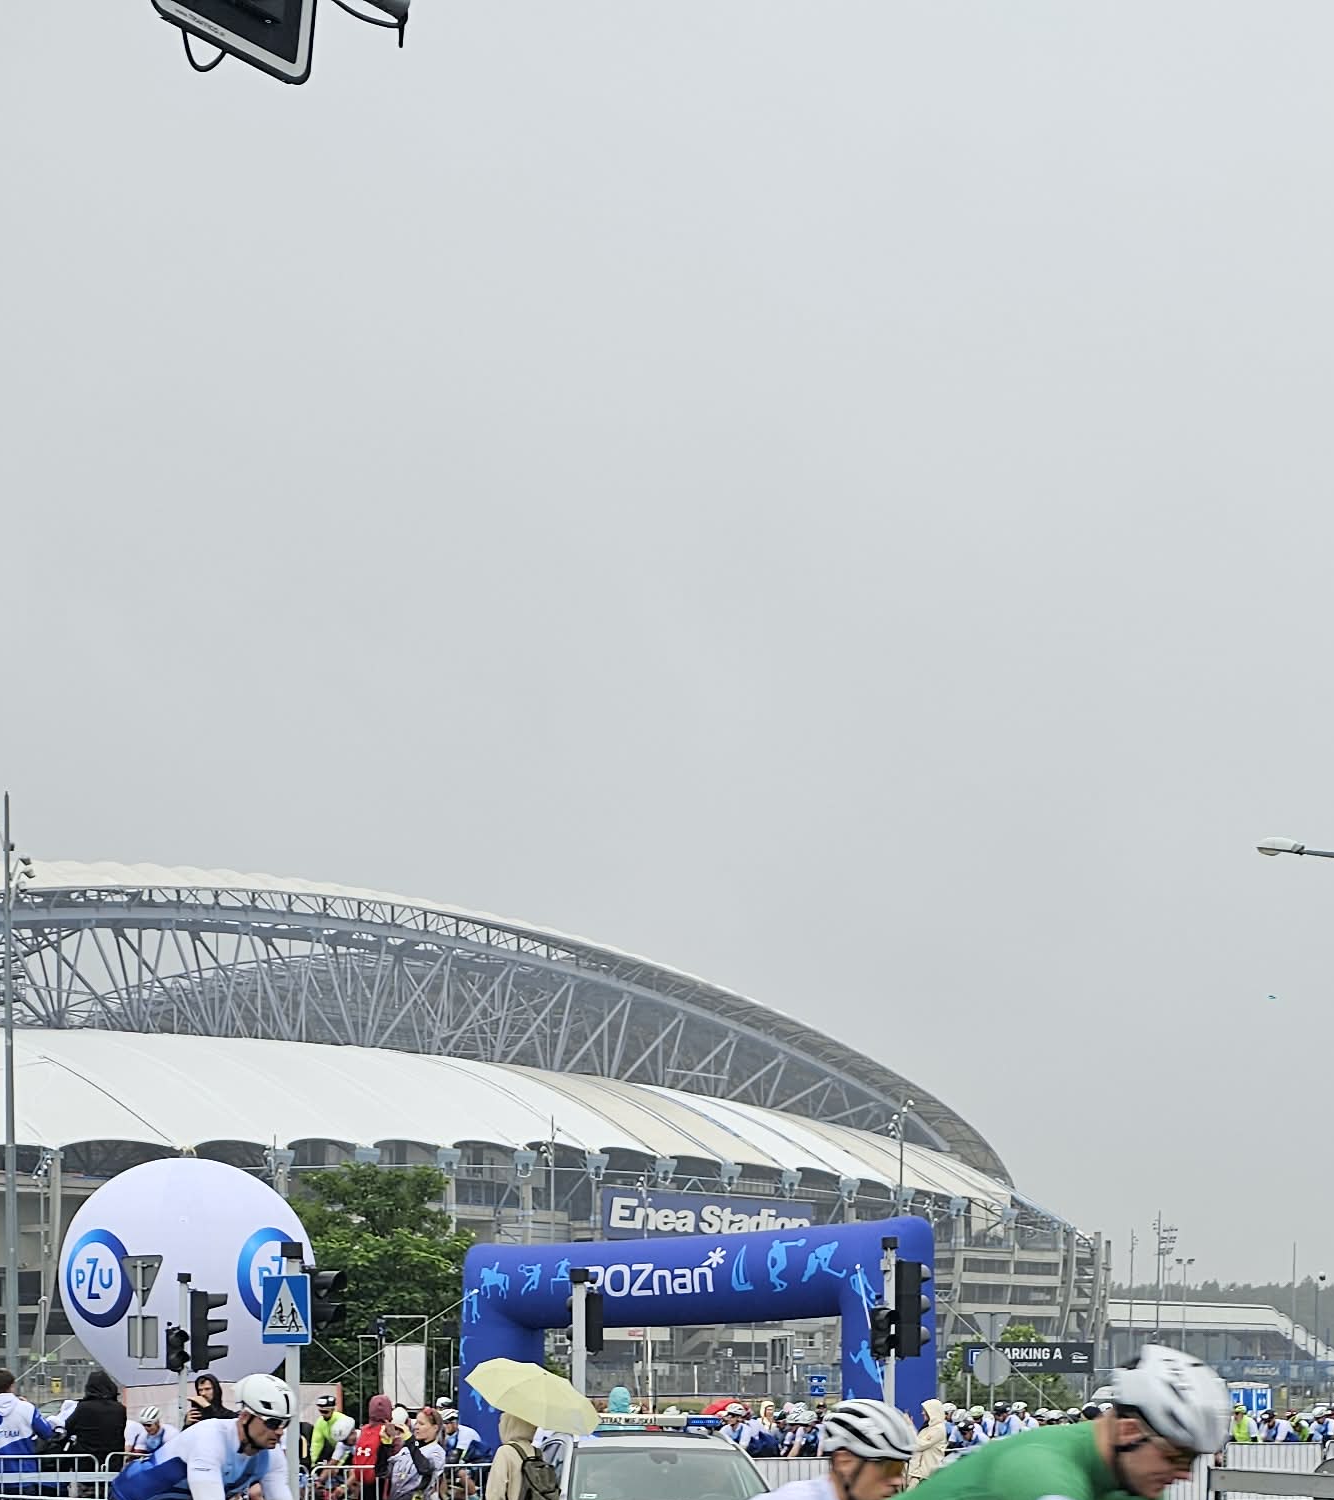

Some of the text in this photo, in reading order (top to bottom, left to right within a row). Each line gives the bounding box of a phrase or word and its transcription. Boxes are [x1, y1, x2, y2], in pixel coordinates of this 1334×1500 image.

[609, 1196, 696, 1233] Enea
[75, 1257, 113, 1300] PZU
[999, 1347, 1051, 1360] ARKING
[1053, 1347, 1063, 1360] A
